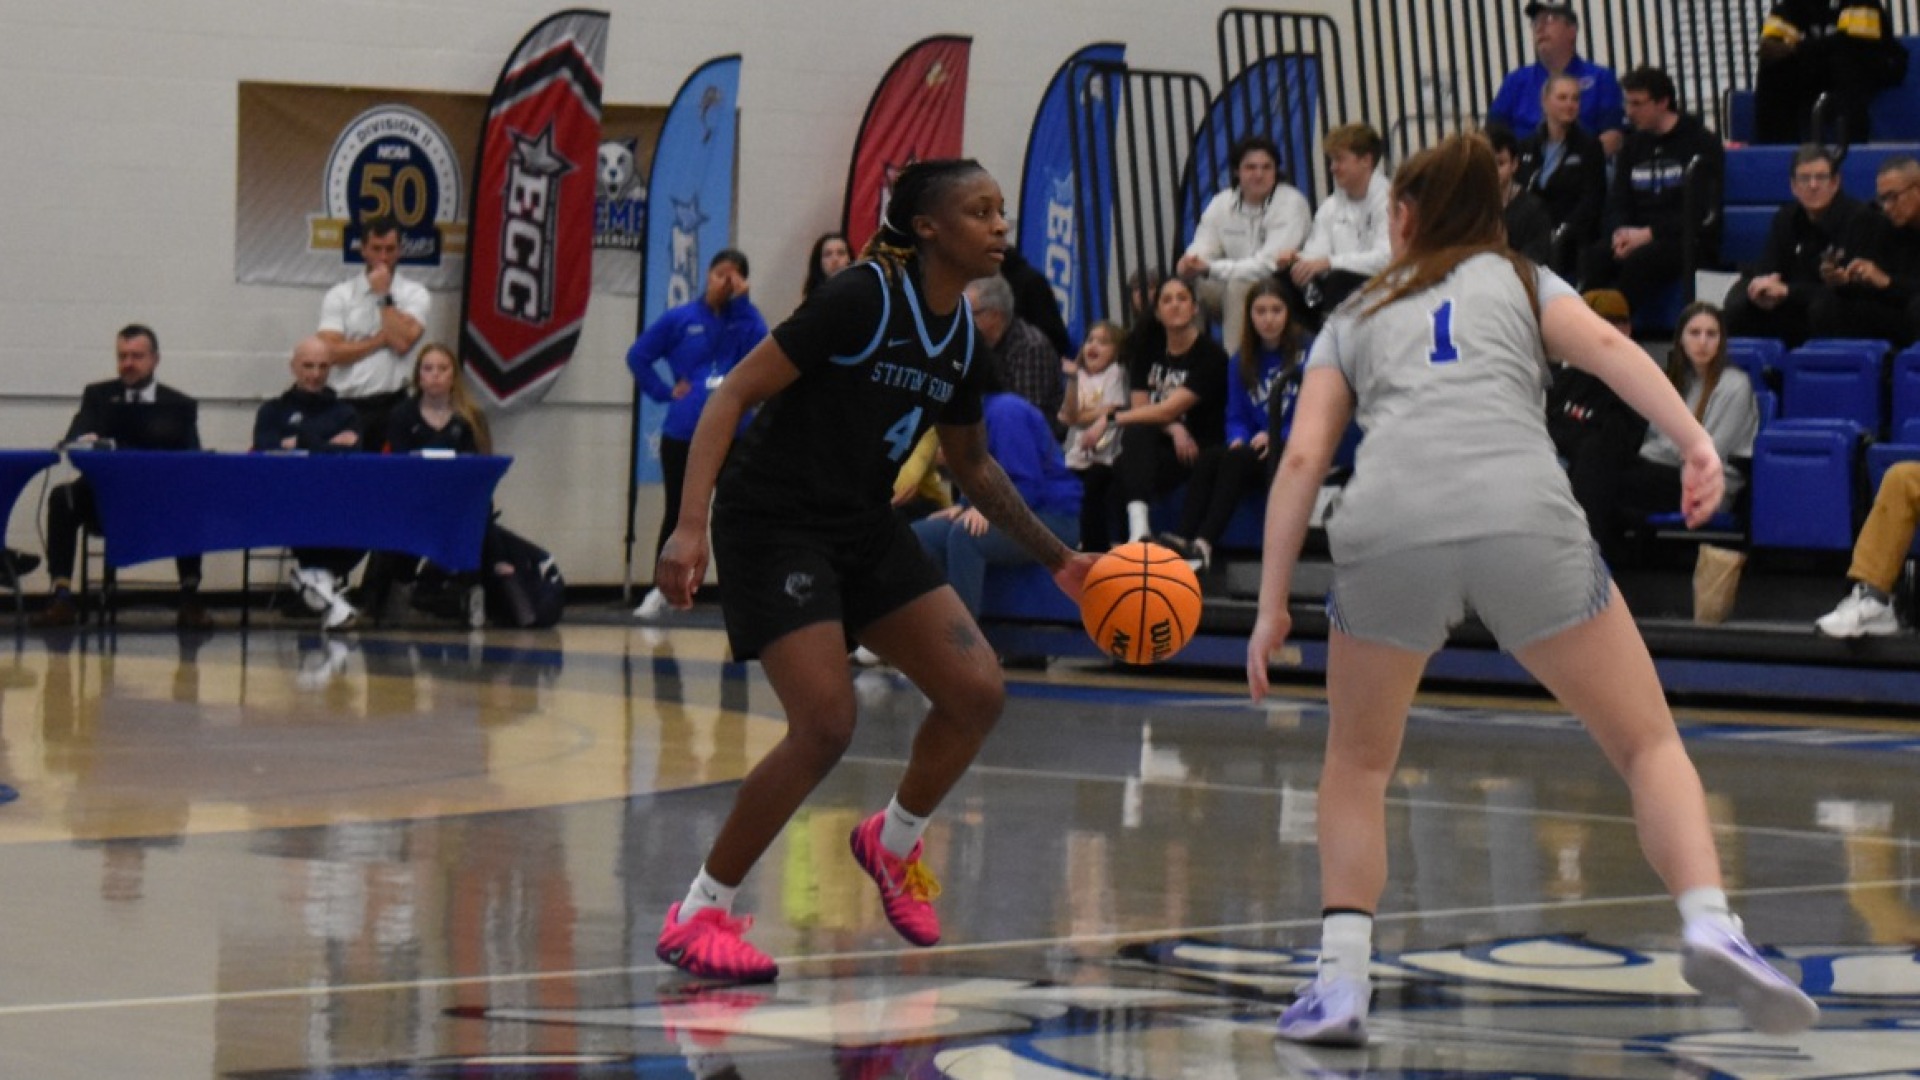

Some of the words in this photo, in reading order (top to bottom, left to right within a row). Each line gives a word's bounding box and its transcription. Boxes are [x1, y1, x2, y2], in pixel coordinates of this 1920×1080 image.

[357, 119, 420, 143] DIVISION
[360, 163, 427, 226] 50
[500, 162, 549, 320] ECC
[1428, 299, 1460, 364] 1
[883, 405, 923, 462] 4
